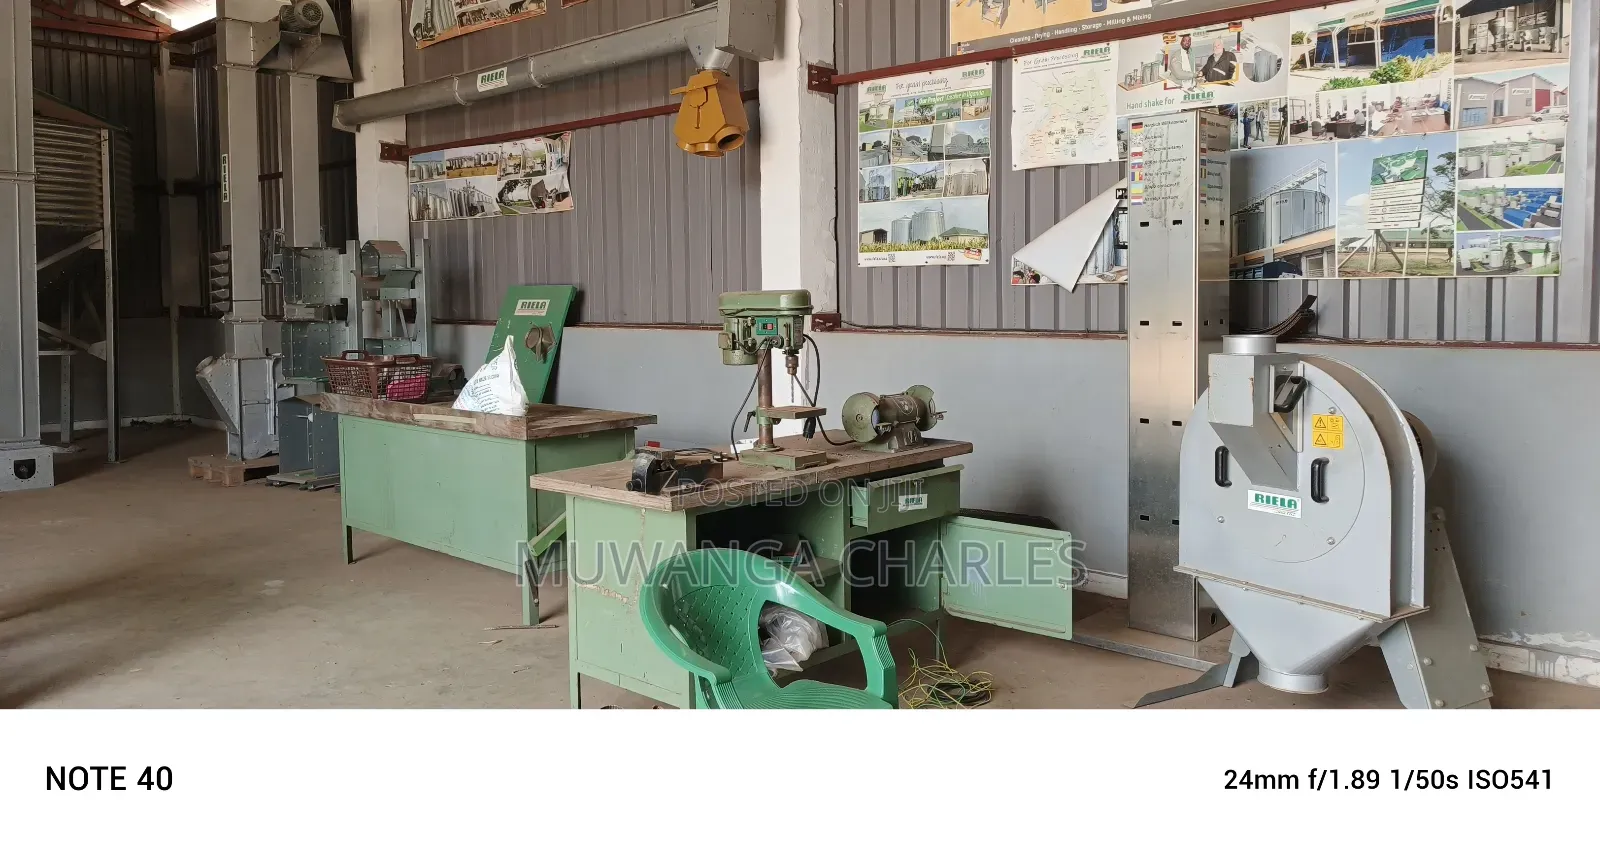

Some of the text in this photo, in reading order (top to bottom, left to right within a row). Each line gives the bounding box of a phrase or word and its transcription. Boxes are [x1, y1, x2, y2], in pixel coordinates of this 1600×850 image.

[1010, 35, 1031, 43] Cleaning
[1034, 31, 1051, 40] Drying
[1054, 27, 1077, 36] Handling
[1081, 22, 1102, 31] Storage
[1106, 18, 1126, 27] Milling
[1132, 13, 1152, 22] Mixing
[1083, 46, 1110, 56] RIELA
[481, 70, 505, 84] RIELA
[961, 69, 985, 78] RIELA
[1126, 101, 1143, 110] Hand
[1144, 98, 1164, 108] shake
[1165, 97, 1175, 105] for
[1183, 91, 1214, 101] RIELA
[520, 301, 547, 309] RIELA
[1255, 493, 1298, 510] RIELA
